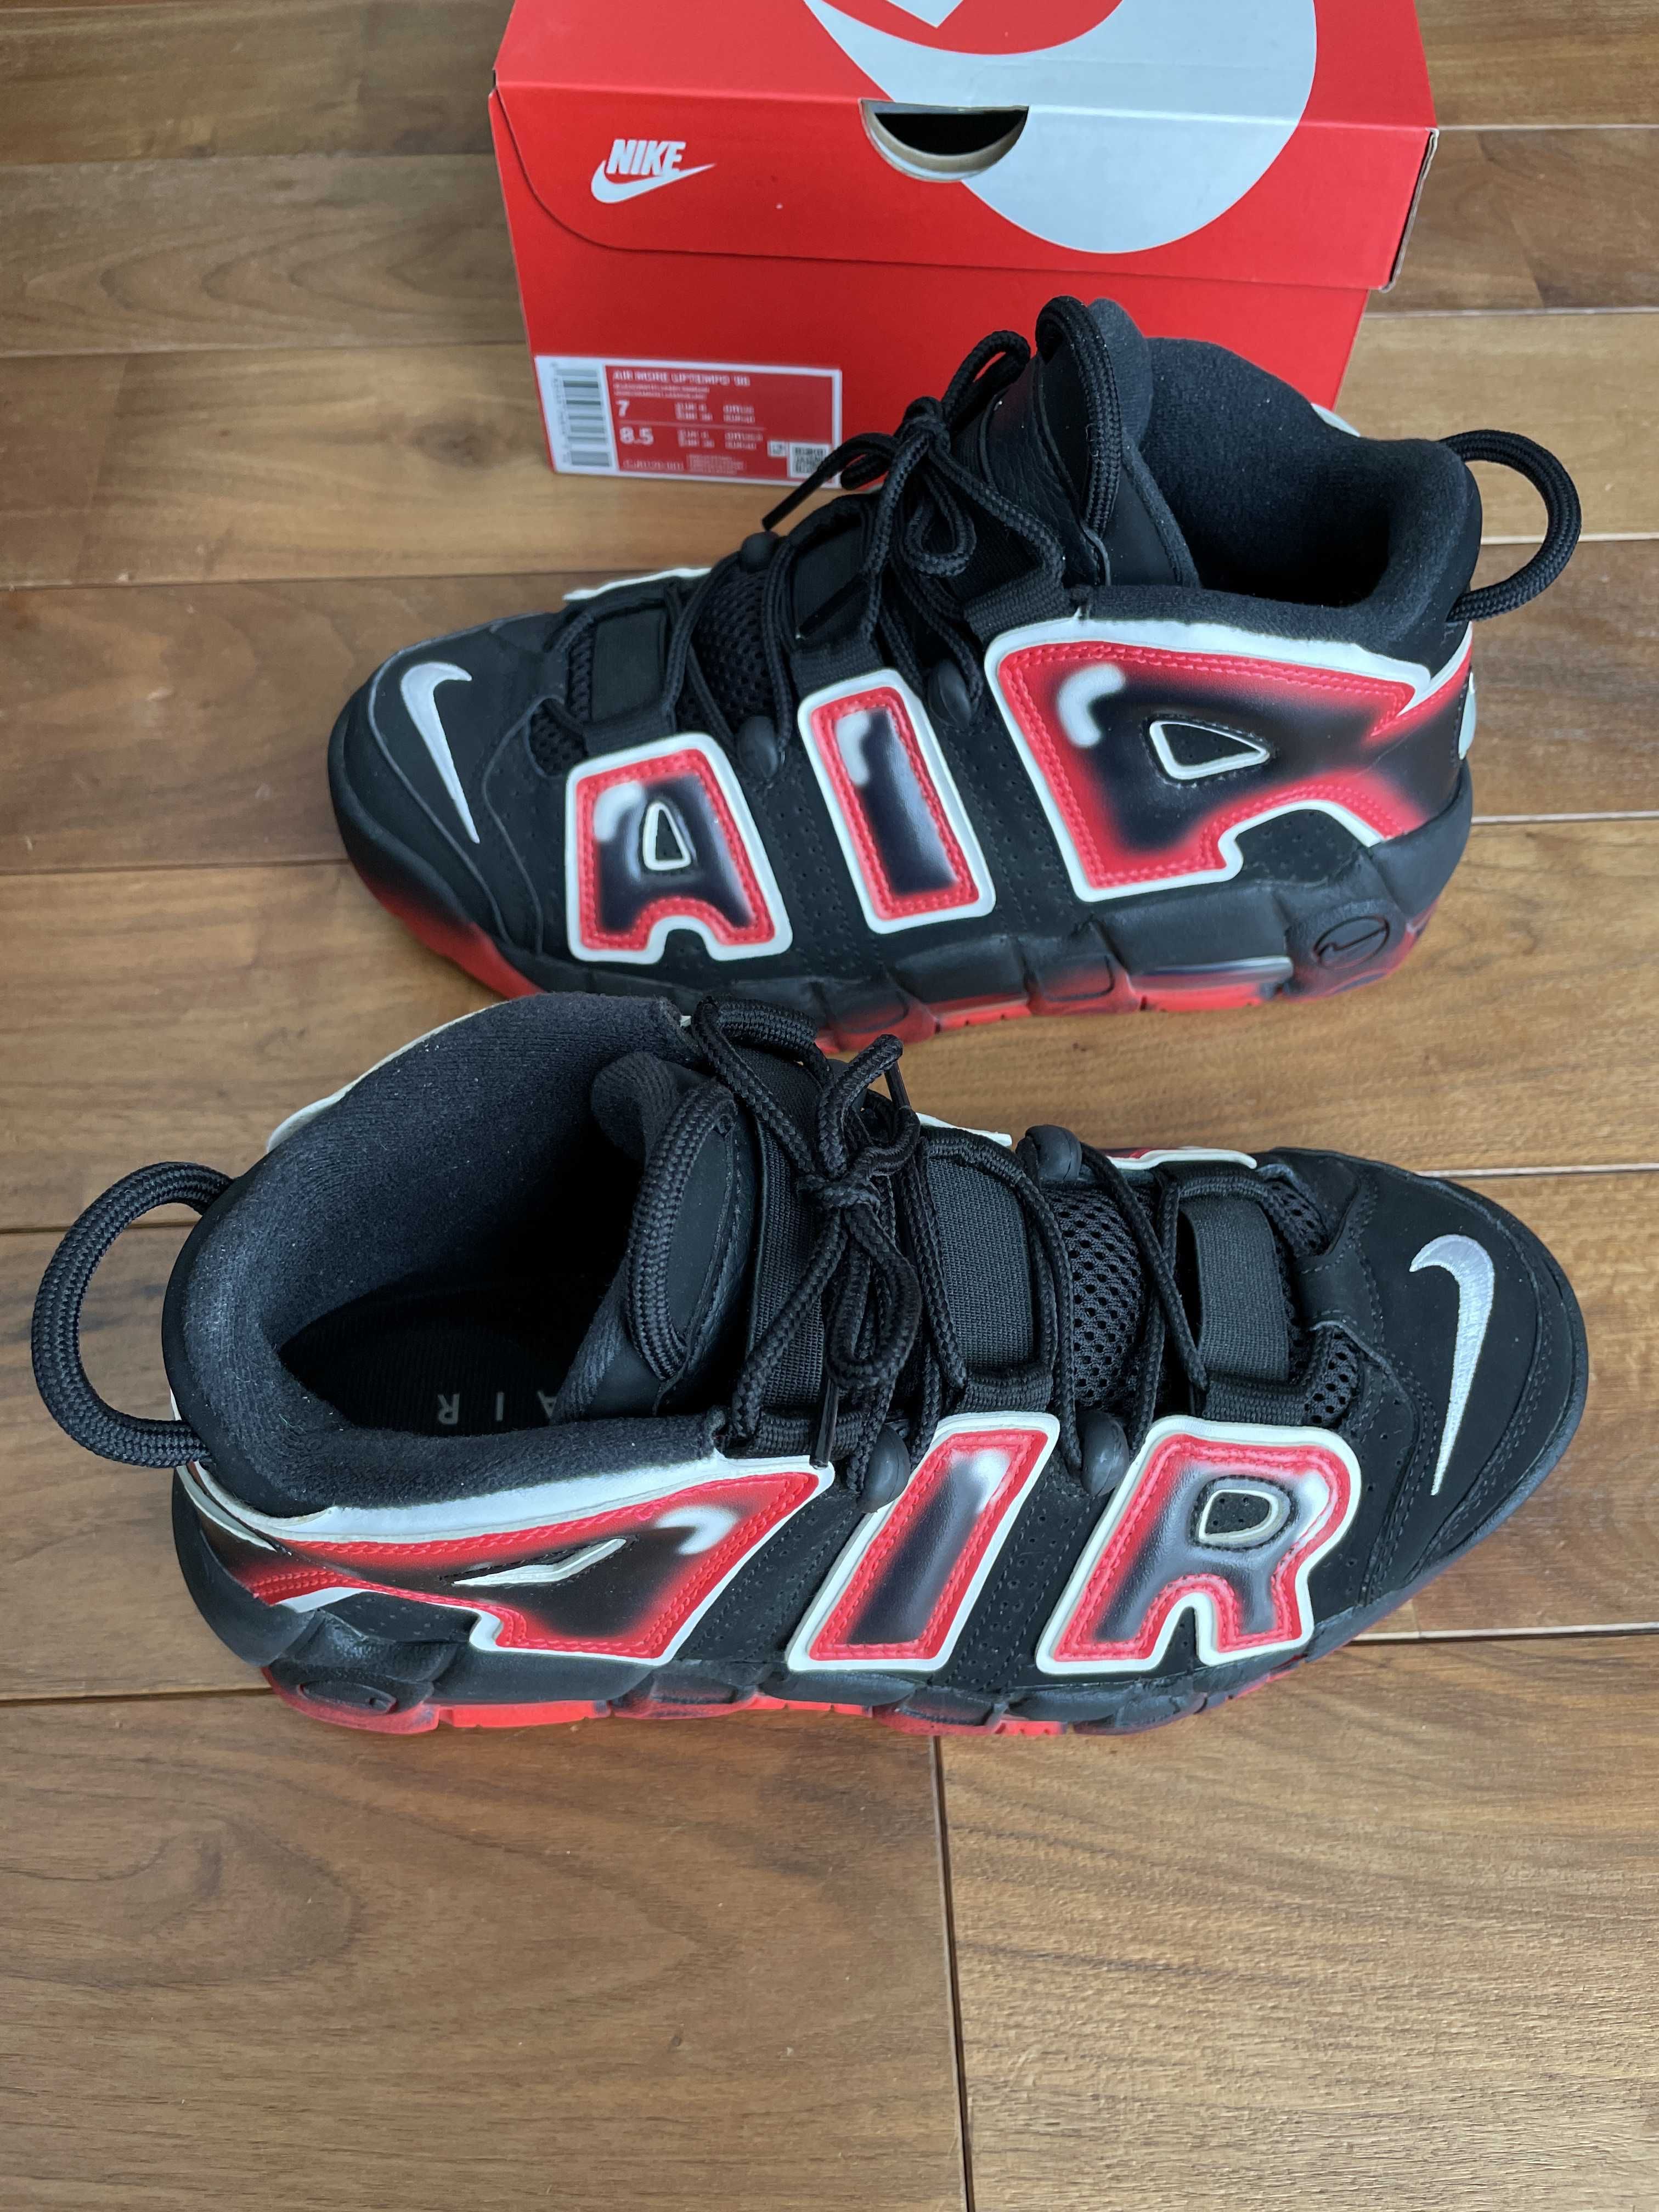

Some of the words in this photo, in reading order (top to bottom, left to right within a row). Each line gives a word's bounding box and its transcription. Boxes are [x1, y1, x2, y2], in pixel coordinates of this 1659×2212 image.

[606, 138, 686, 176] NIKE
[613, 370, 631, 381] AIR
[616, 399, 630, 417] 7
[619, 426, 654, 445] 8.5
[437, 1390, 558, 1425] AIR
